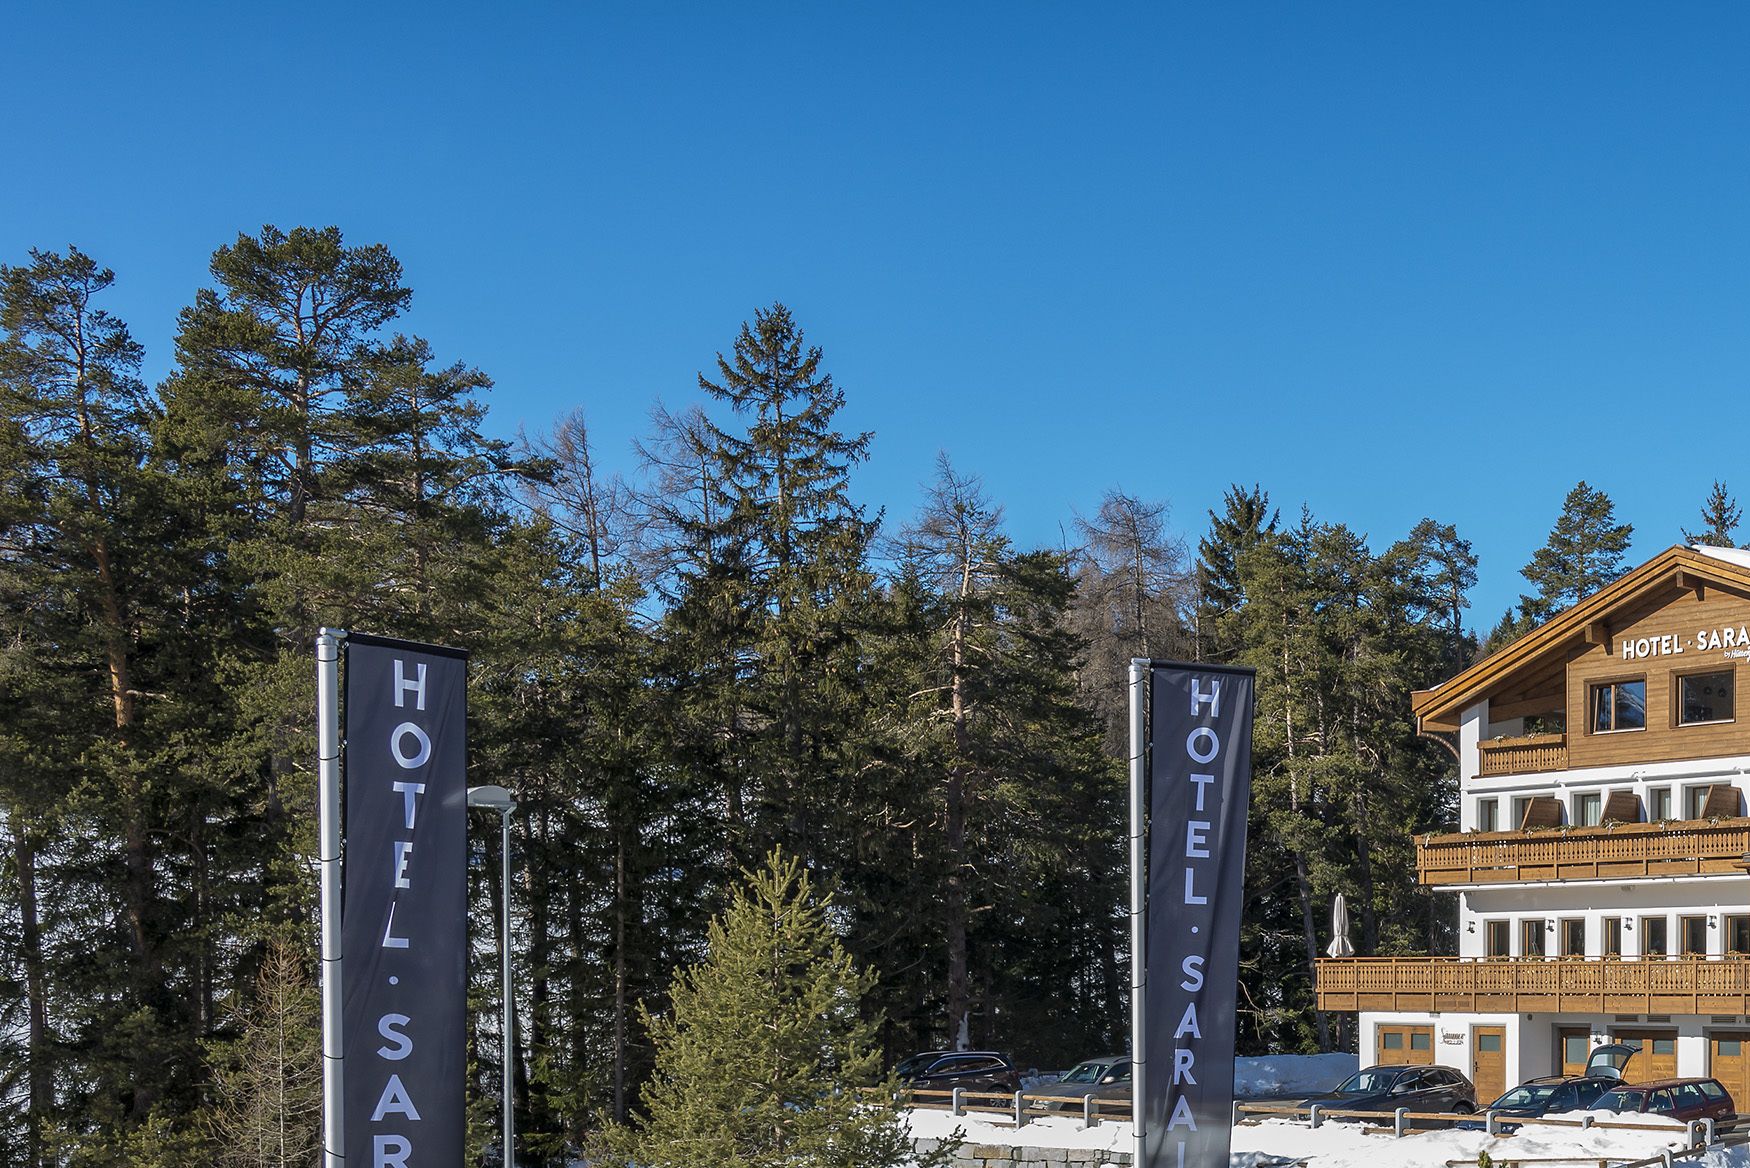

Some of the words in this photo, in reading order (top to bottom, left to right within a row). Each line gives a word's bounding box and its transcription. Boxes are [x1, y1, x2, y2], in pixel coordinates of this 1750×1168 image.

[1622, 634, 1684, 660] HOTEL
[382, 659, 432, 948] HOTEL
[1184, 678, 1220, 905] HOTEL
